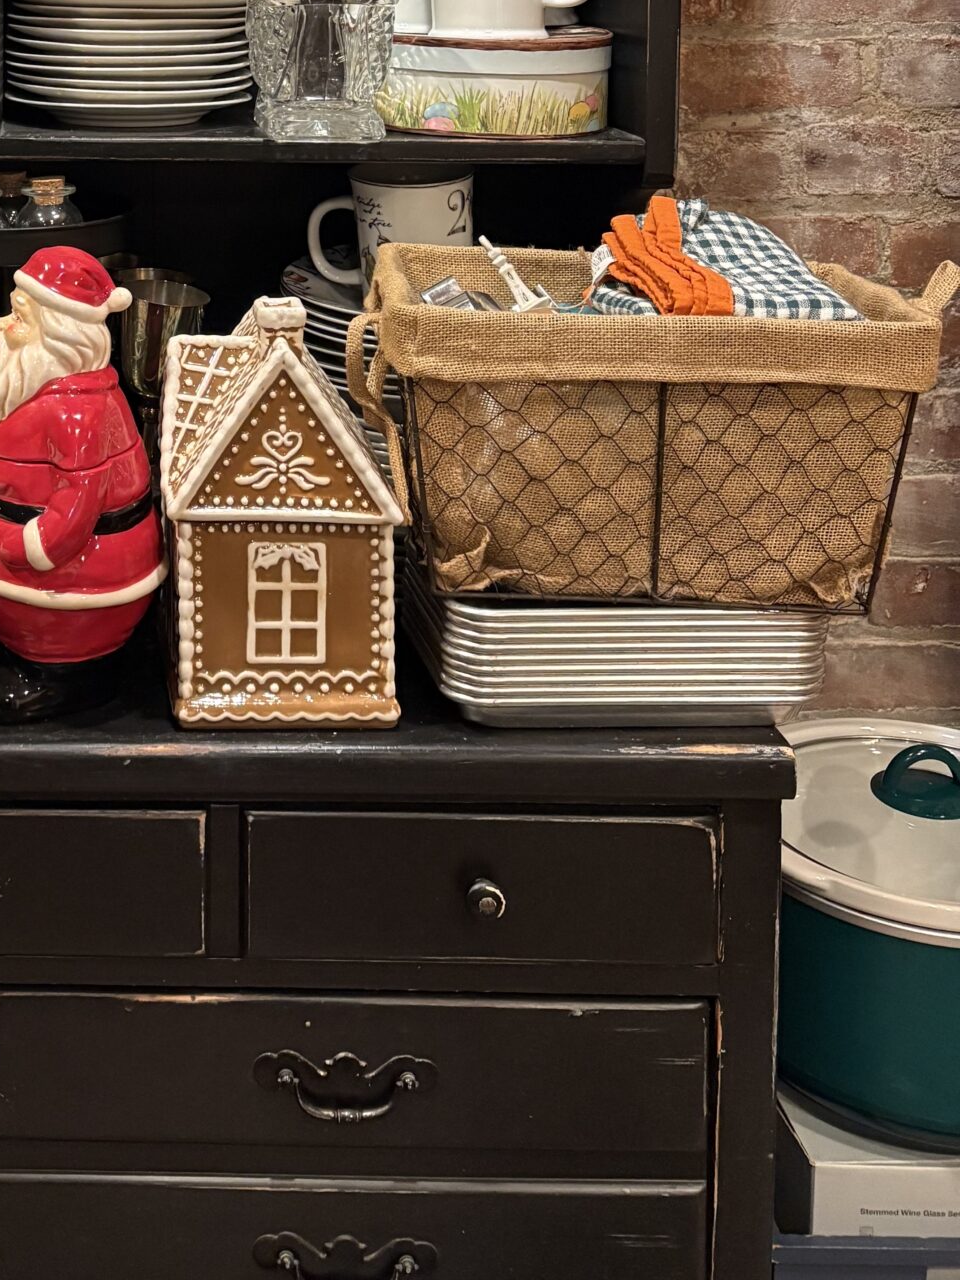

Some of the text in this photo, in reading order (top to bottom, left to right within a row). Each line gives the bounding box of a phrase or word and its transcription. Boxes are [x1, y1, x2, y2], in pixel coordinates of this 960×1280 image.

[446, 189, 467, 237] 2
[860, 1208, 899, 1216] Stemmed
[901, 1209, 921, 1217] Wine
[923, 1209, 946, 1217] Glass
